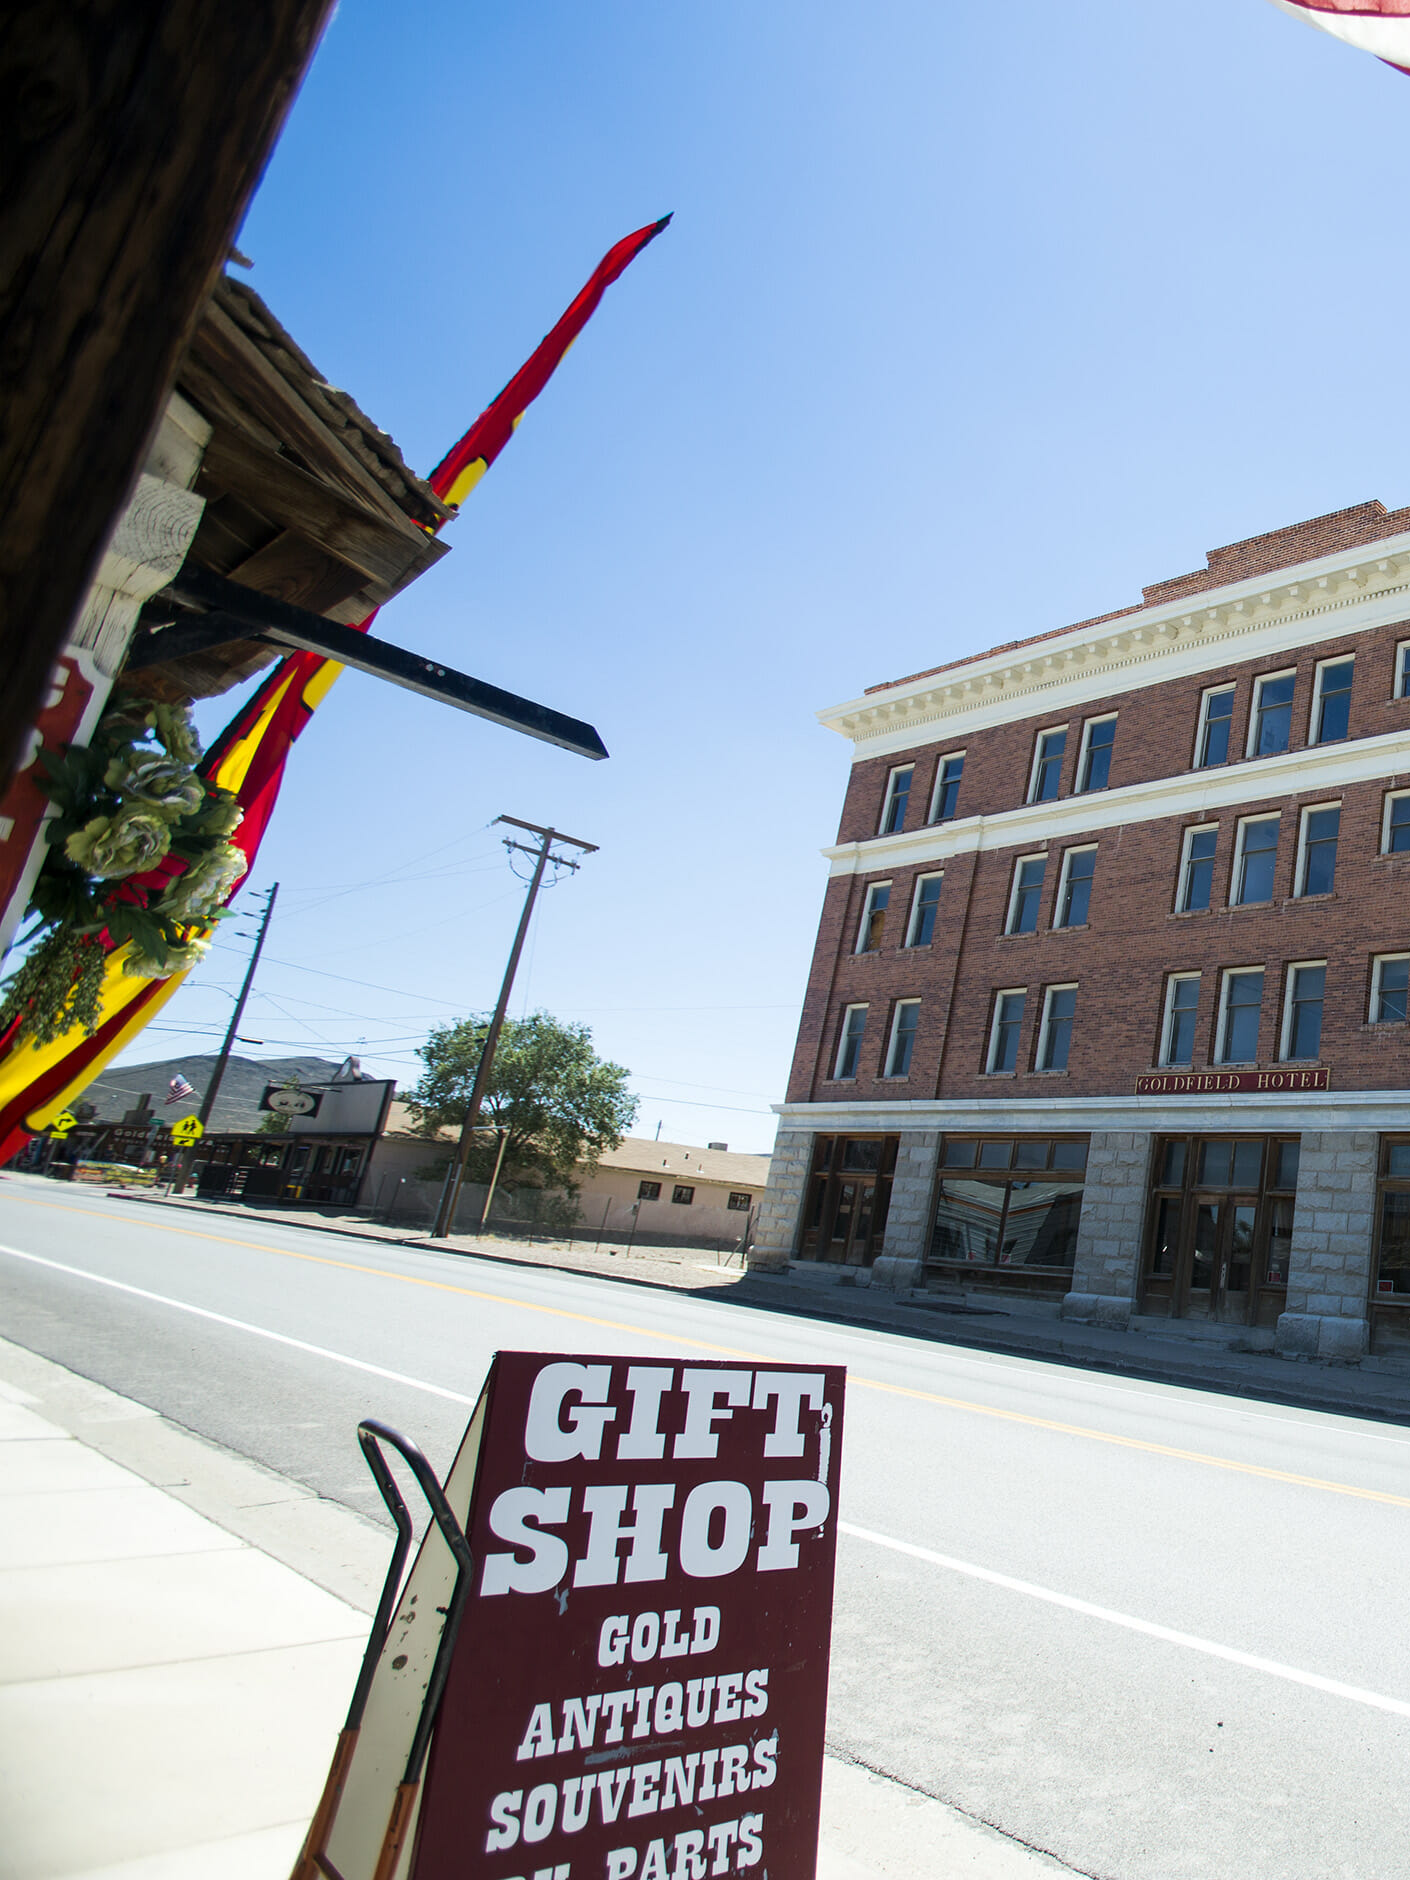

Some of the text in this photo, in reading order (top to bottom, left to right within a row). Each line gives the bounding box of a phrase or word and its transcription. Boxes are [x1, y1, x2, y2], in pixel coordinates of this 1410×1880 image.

[1138, 1071, 1325, 1092] GOLDFIELD HOTEL
[524, 1362, 826, 1462] GIFT
[480, 1480, 830, 1597] SHOP
[598, 1605, 721, 1668] GOLD
[515, 1667, 770, 1762] ANTIQUES
[484, 1738, 778, 1854] SOUVENIRS
[605, 1813, 764, 1880] PARTS
